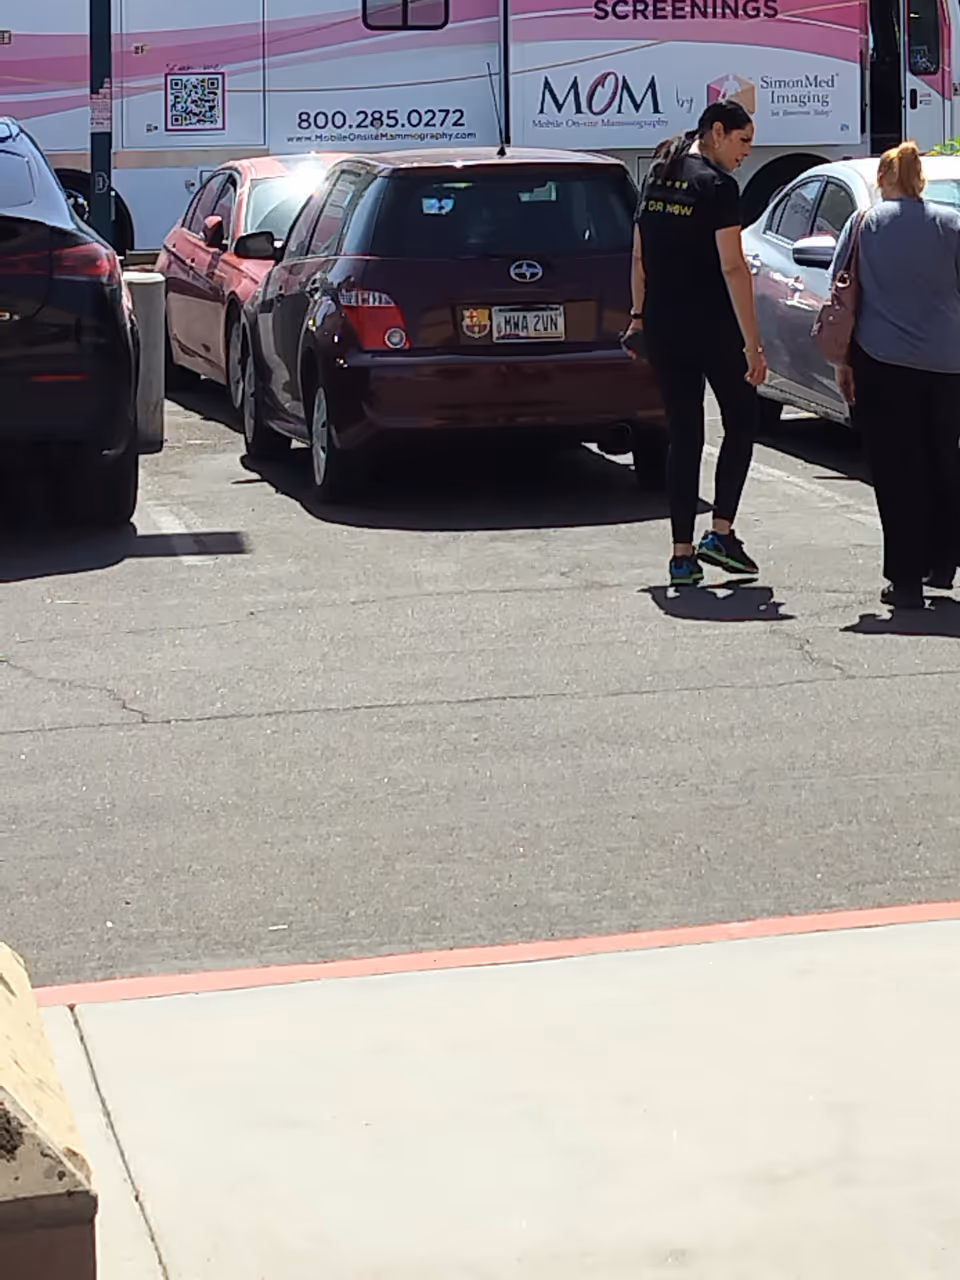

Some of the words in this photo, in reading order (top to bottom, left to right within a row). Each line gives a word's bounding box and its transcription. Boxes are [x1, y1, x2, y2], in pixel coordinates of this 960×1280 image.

[760, 74, 835, 89] SimonMed
[538, 71, 664, 116] MOM
[676, 84, 694, 113] by
[770, 90, 830, 108] Imaging
[297, 109, 465, 130] 800.285.0272
[286, 131, 477, 143] www.MobileOnsiteMammography.com
